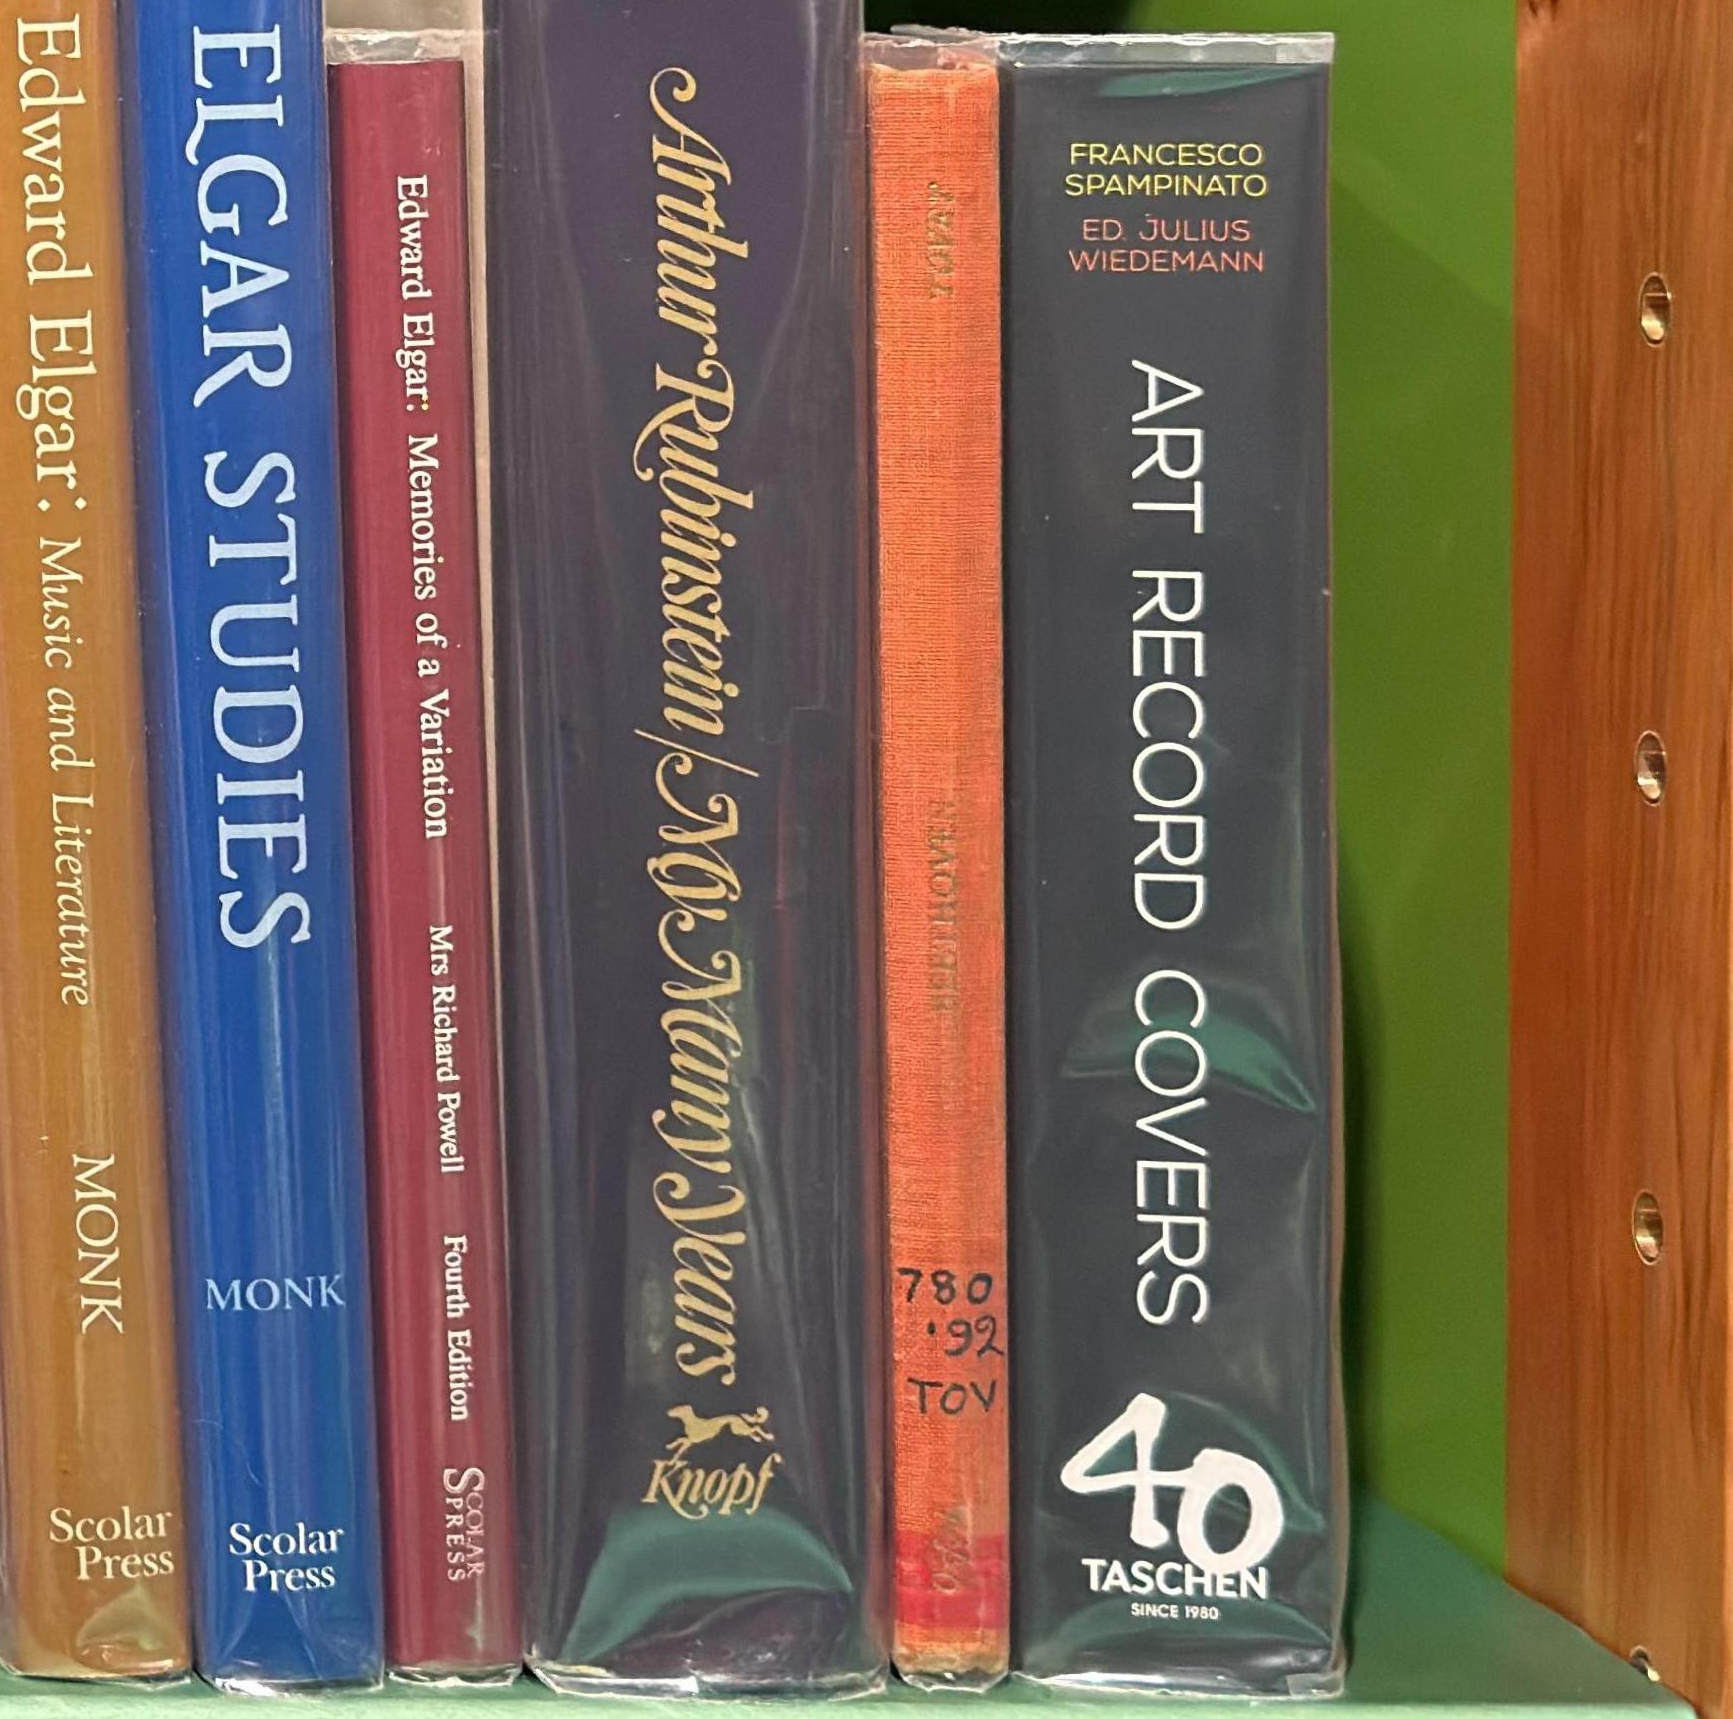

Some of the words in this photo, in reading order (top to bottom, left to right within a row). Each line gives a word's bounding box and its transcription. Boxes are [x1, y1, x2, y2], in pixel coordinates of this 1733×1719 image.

[16, 12, 92, 286] Edward
[1065, 172, 1267, 198] SPAMPINATO
[1070, 143, 1262, 166] FRANCESCO
[185, 23, 293, 408] ELGAR
[396, 175, 433, 303] Edward
[650, 66, 748, 354] Arthur
[1083, 218, 1125, 241] ED.
[1140, 217, 1250, 241] JULIUS
[1068, 249, 1263, 272] WIEDEMANN
[396, 312, 433, 412] Elgar:
[17, 310, 97, 512] Elgar:
[1131, 359, 1205, 533] ART
[406, 434, 444, 602] Memories
[38, 536, 84, 668] Music
[416, 611, 447, 651] of
[45, 688, 95, 772] and
[203, 451, 313, 949] STUDIES
[417, 688, 452, 839] Variation
[1131, 570, 1206, 930] RECORD
[49, 791, 95, 1006] Literature
[429, 926, 455, 977] Mrs
[431, 983, 460, 1084] Richard
[438, 1092, 465, 1172] Powell
[1134, 971, 1210, 1325] COVERS
[72, 1153, 124, 1335] MONK
[443, 1235, 469, 1321] Fourth
[651, 1172, 747, 1386] Years
[898, 1268, 992, 1304] 780
[206, 1274, 345, 1310] MONK
[447, 1328, 474, 1421] Edition
[908, 1378, 997, 1414] TOV
[49, 1507, 172, 1543] Scolar
[641, 1454, 783, 1519] Knopf
[1060, 1392, 1285, 1571] 40
[76, 1543, 174, 1580] Press
[228, 1522, 344, 1557] Scolar
[242, 1557, 335, 1592] Press
[1083, 1560, 1267, 1599] TASCHEN
[1131, 1603, 1179, 1620] SINCE
[1185, 1603, 1220, 1620] 1980
